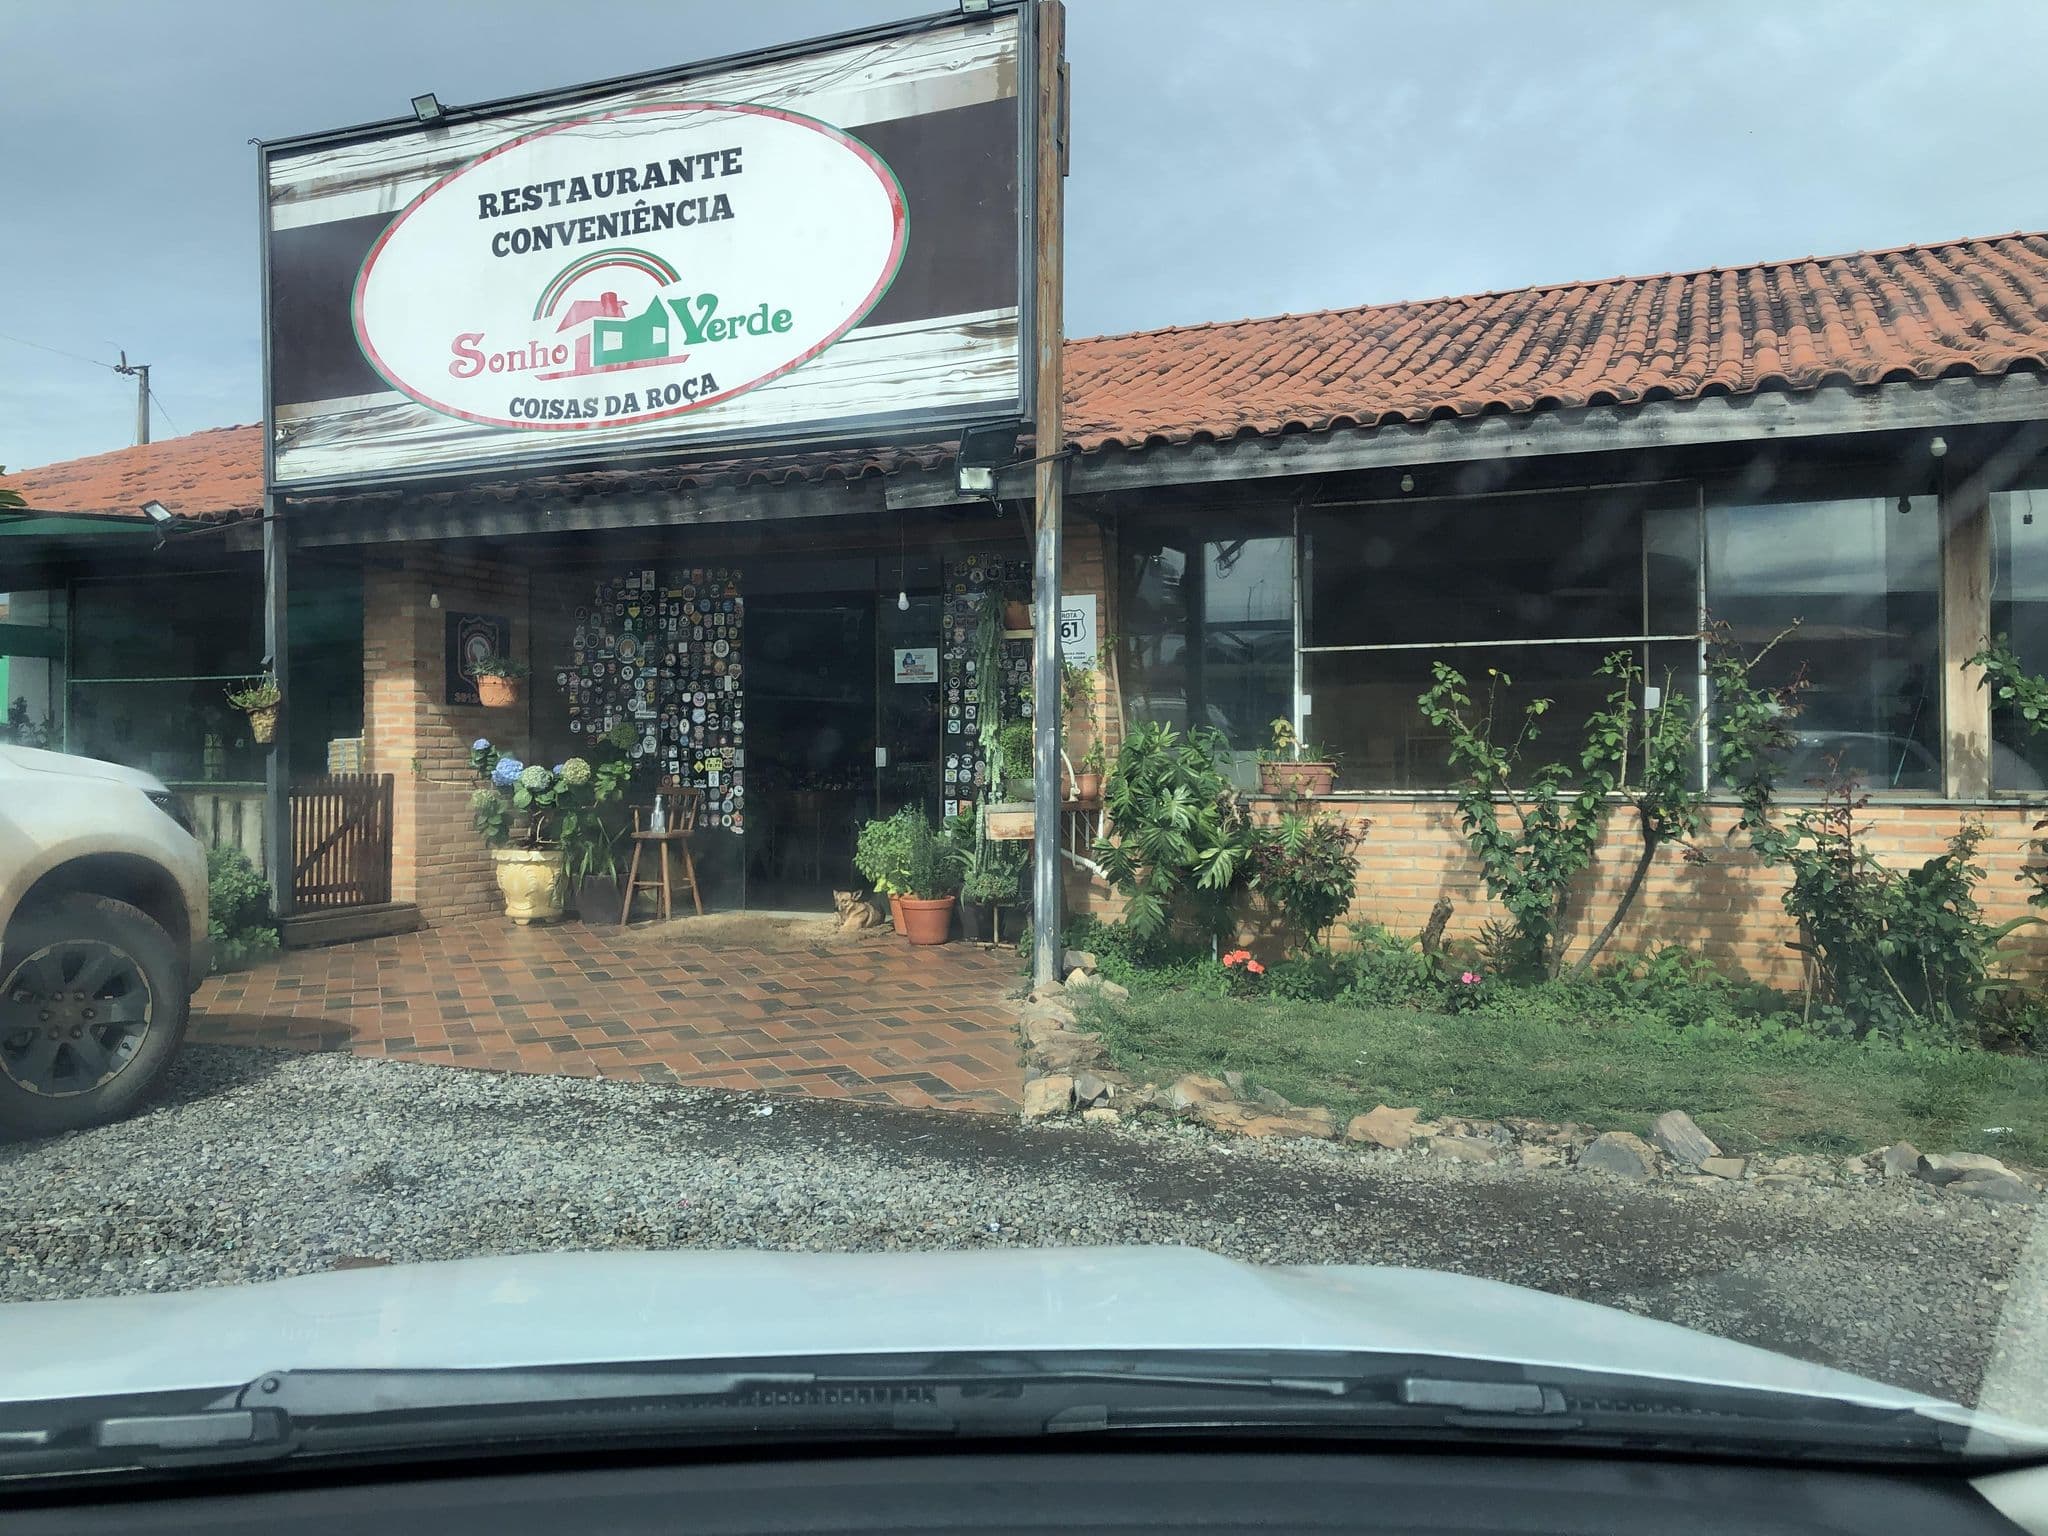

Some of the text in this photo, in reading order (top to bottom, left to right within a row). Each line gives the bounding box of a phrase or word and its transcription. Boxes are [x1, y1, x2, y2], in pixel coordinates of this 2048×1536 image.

[478, 147, 743, 220] RESTAURANTE
[492, 193, 735, 257] CONVENIÊNCIA
[449, 293, 793, 378] Sonho Verde
[509, 372, 720, 420] COISAS DA ROÇA
[1061, 621, 1078, 638] 61
